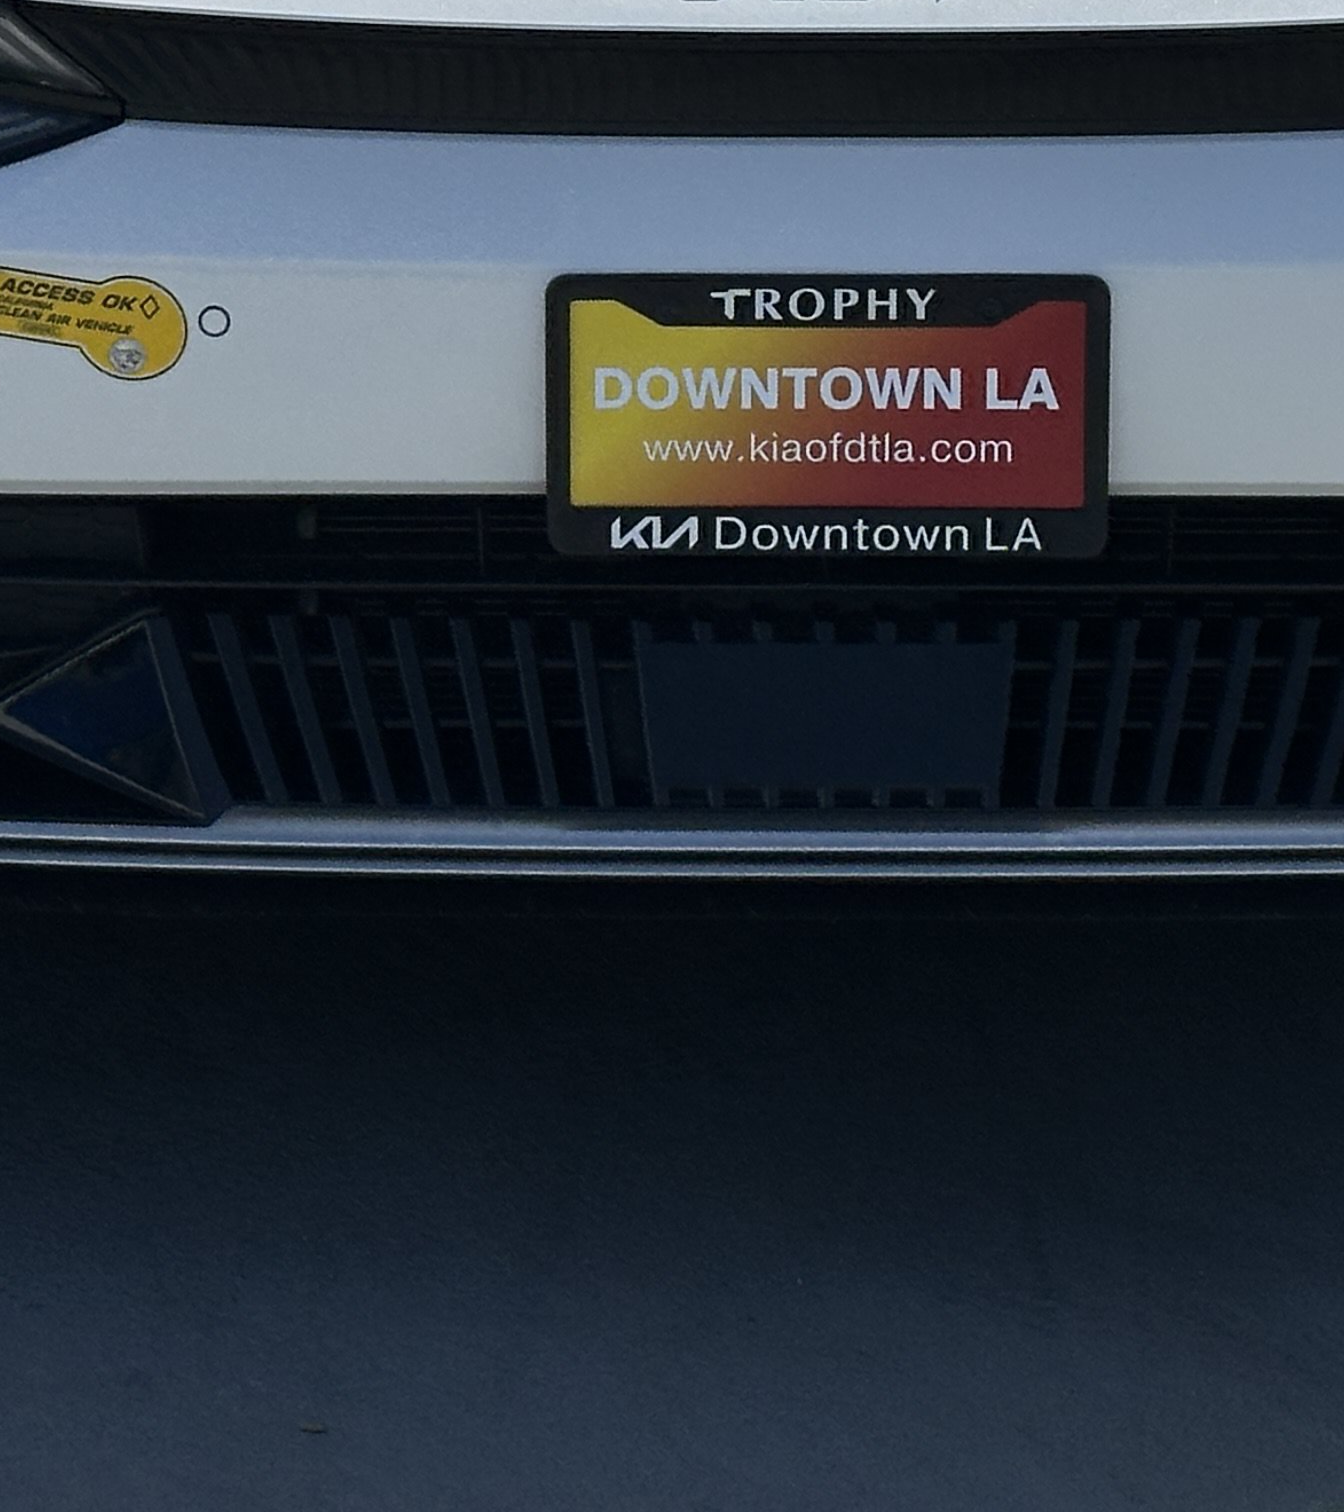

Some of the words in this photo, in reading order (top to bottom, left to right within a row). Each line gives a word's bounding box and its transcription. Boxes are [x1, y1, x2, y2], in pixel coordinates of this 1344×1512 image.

[0, 278, 96, 305] ACCESS
[102, 294, 139, 311] OK
[710, 288, 936, 322] TROPHY
[47, 313, 72, 326] AIR
[76, 318, 135, 335] VEHICLE
[594, 367, 962, 411] DOWNTOWN
[985, 368, 1059, 411] LA
[643, 431, 1013, 465] www.kiaofdtla.com
[715, 516, 969, 552] Downtown
[986, 517, 1043, 552] LA
